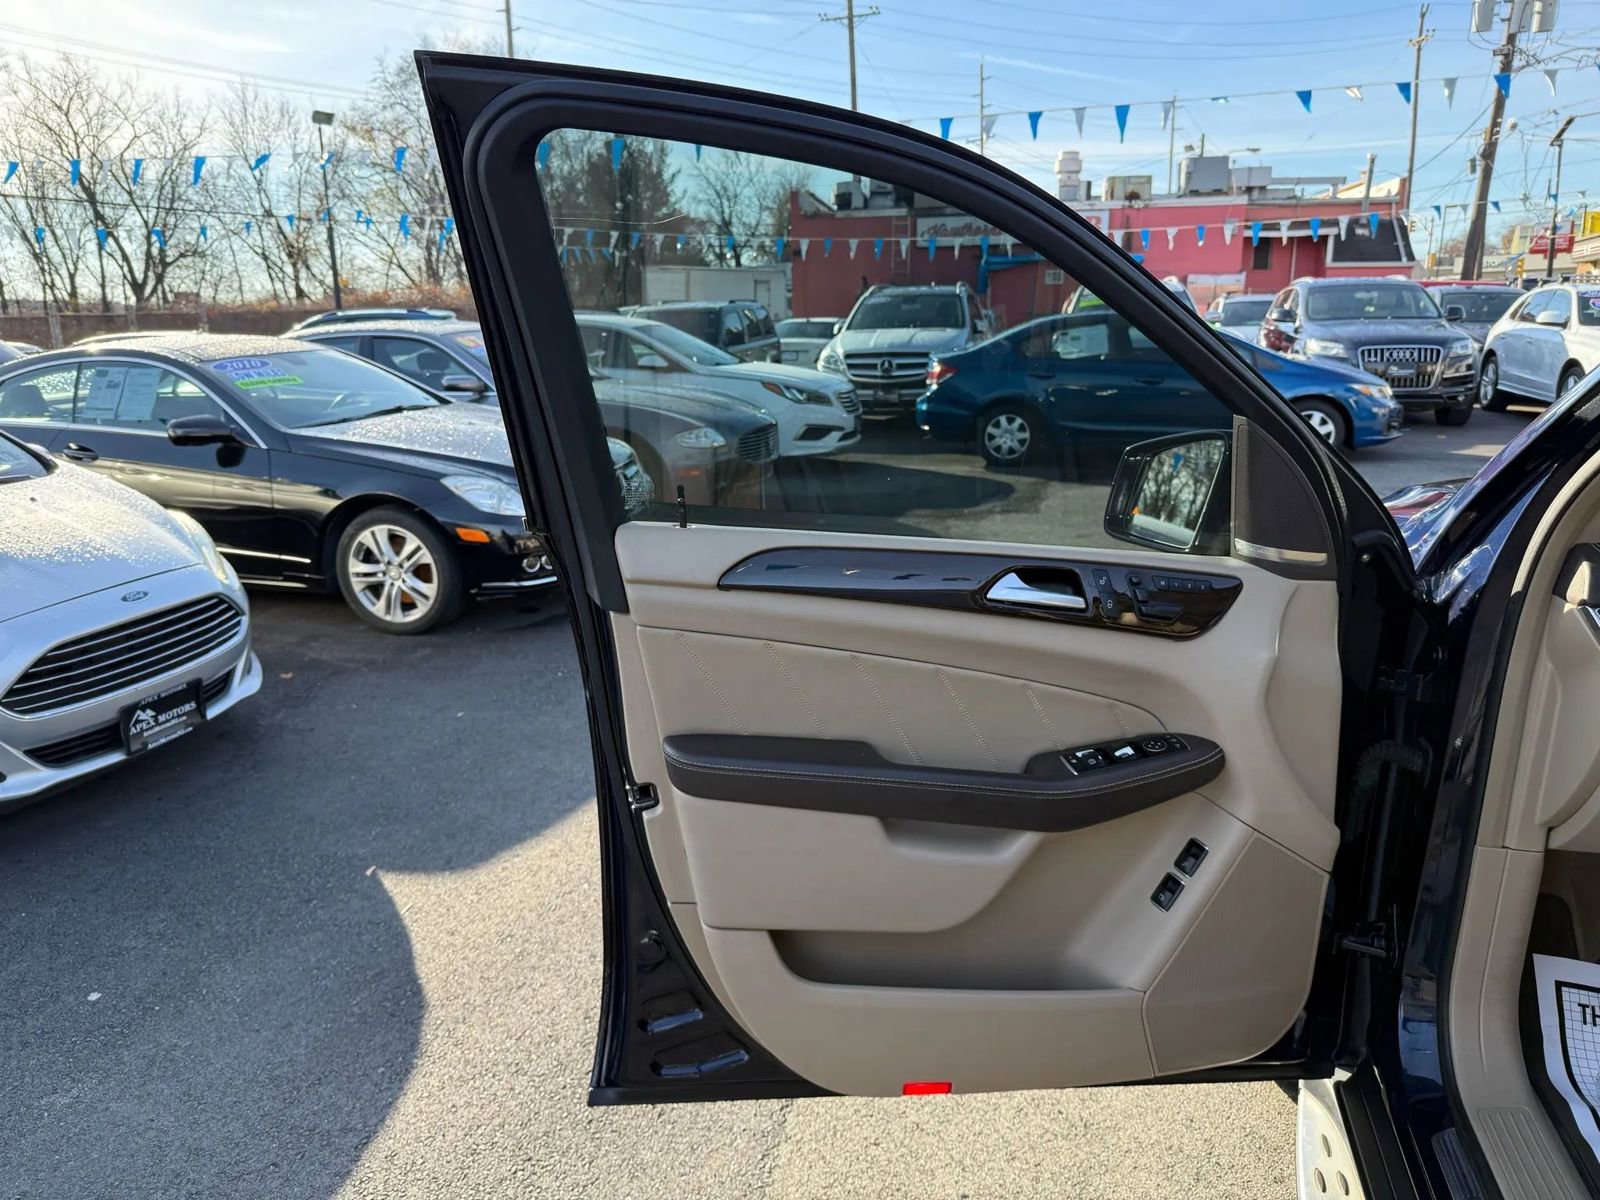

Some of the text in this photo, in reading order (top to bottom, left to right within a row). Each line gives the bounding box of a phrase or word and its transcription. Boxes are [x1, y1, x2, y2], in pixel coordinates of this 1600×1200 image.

[224, 360, 261, 371] 2010
[130, 718, 157, 736] APEX
[157, 700, 197, 723] MOTORS
